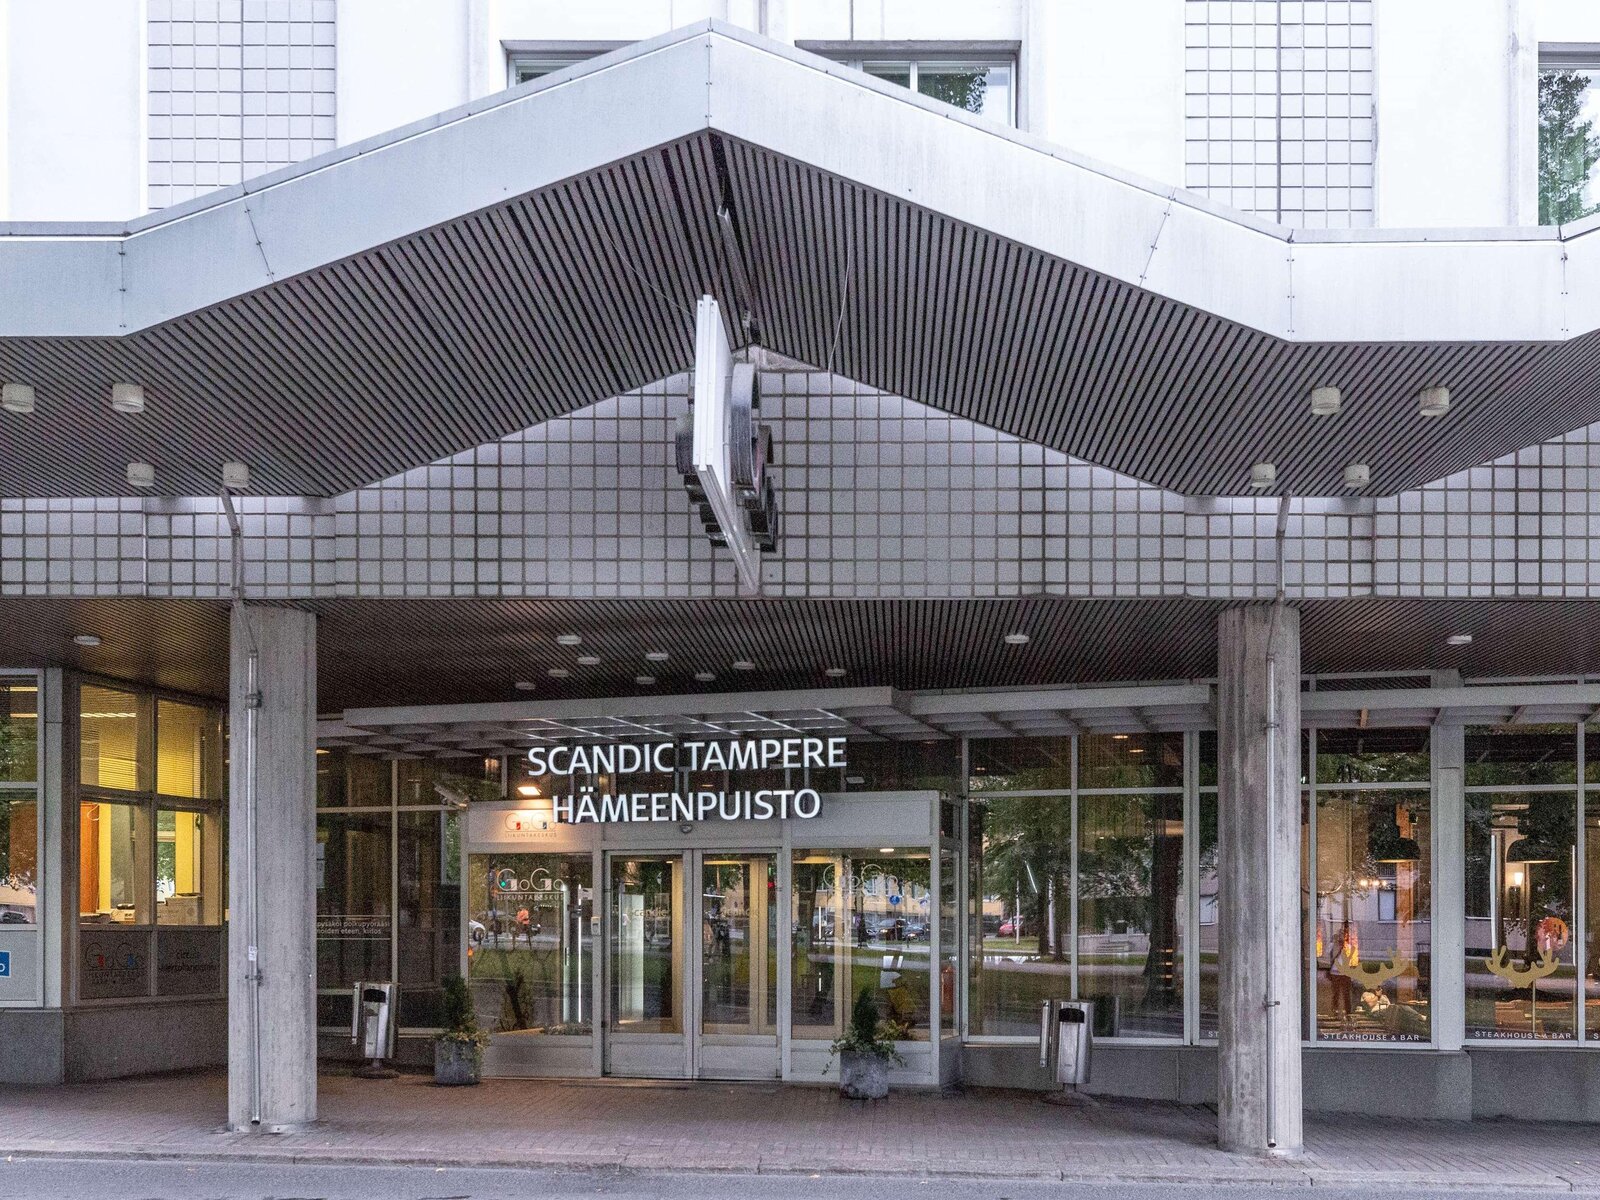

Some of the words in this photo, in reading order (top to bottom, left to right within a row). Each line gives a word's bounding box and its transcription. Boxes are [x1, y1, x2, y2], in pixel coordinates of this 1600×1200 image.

[527, 743, 674, 776] SCANDIC
[684, 737, 847, 771] TAMPERE
[552, 786, 821, 823] HÄMEENPUISTO
[497, 868, 564, 891] GoGo
[1323, 1033, 1387, 1041] STEAKHOUSE
[1475, 1031, 1539, 1039] STEAKHOUSE
